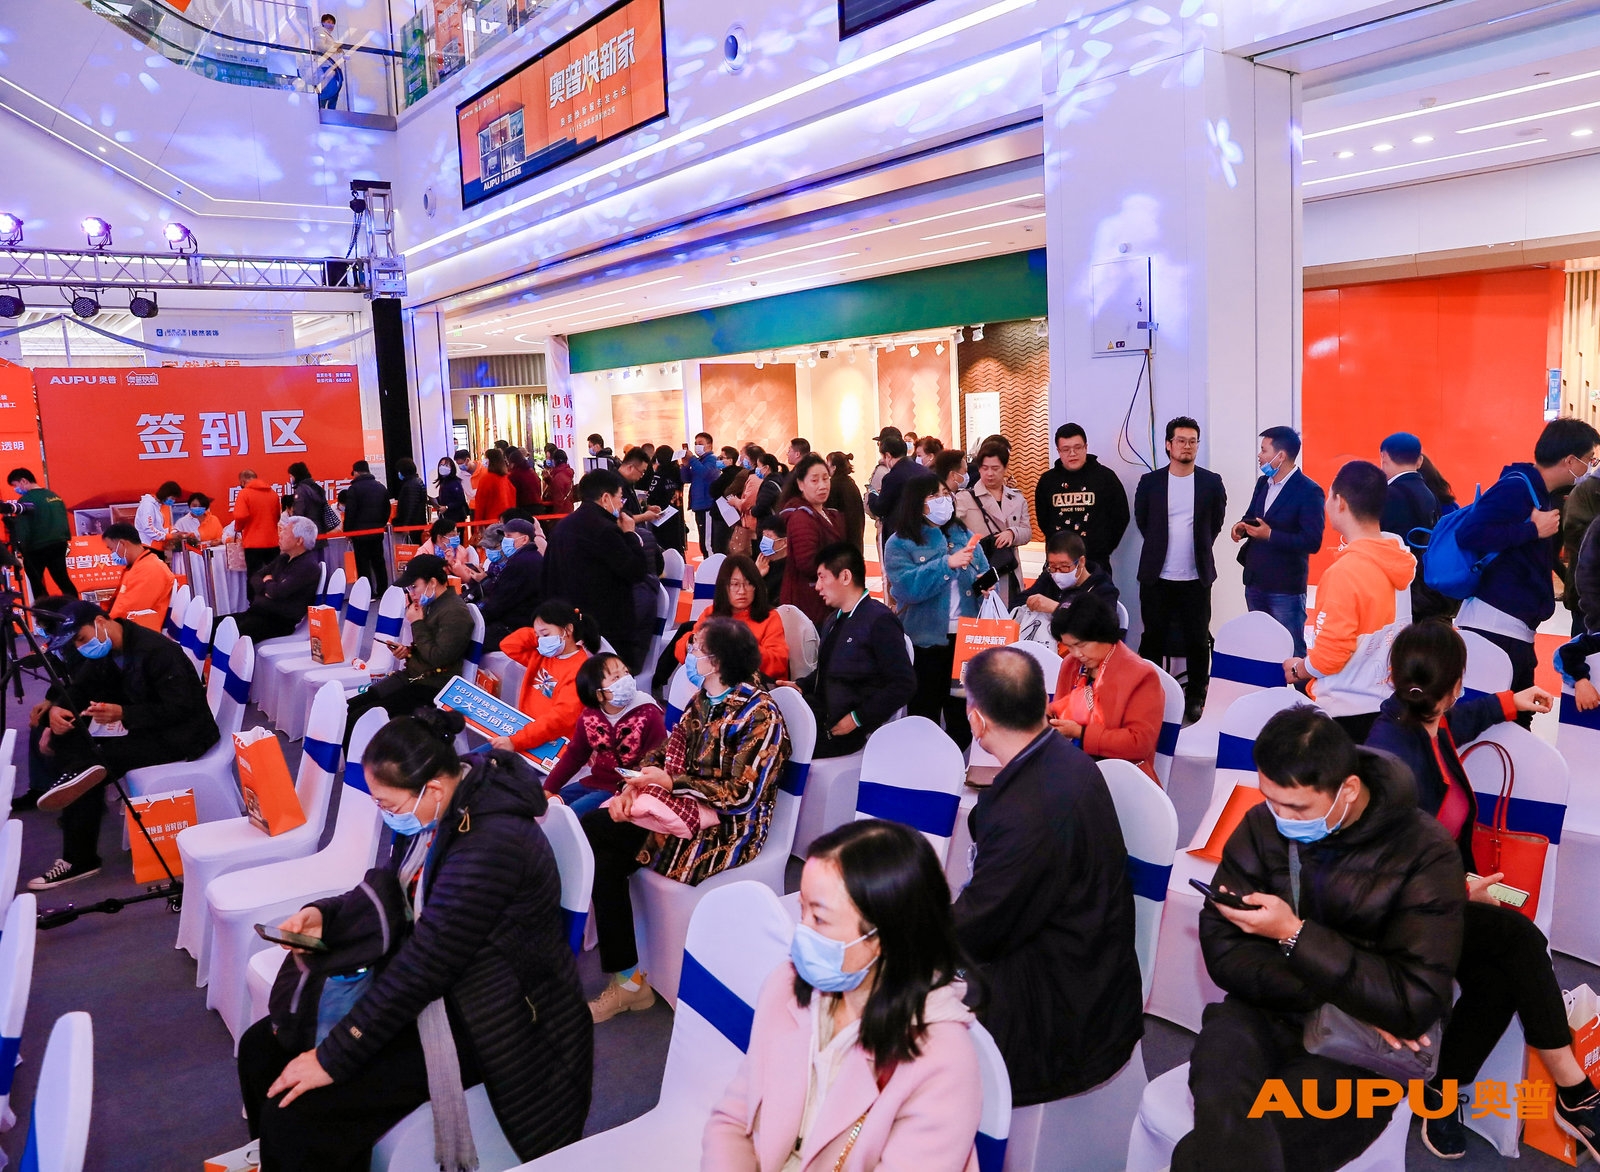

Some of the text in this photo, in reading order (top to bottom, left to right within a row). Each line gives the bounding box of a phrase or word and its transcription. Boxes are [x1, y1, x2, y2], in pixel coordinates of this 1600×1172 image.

[550, 27, 636, 109] 奥普焕新家
[50, 375, 97, 385] AUPU
[99, 375, 117, 385] 奥普
[136, 410, 307, 460] 签到区
[0, 441, 25, 451] 透明
[1053, 492, 1095, 507] AUPU
[1584, 1045, 1600, 1070] 奥普
